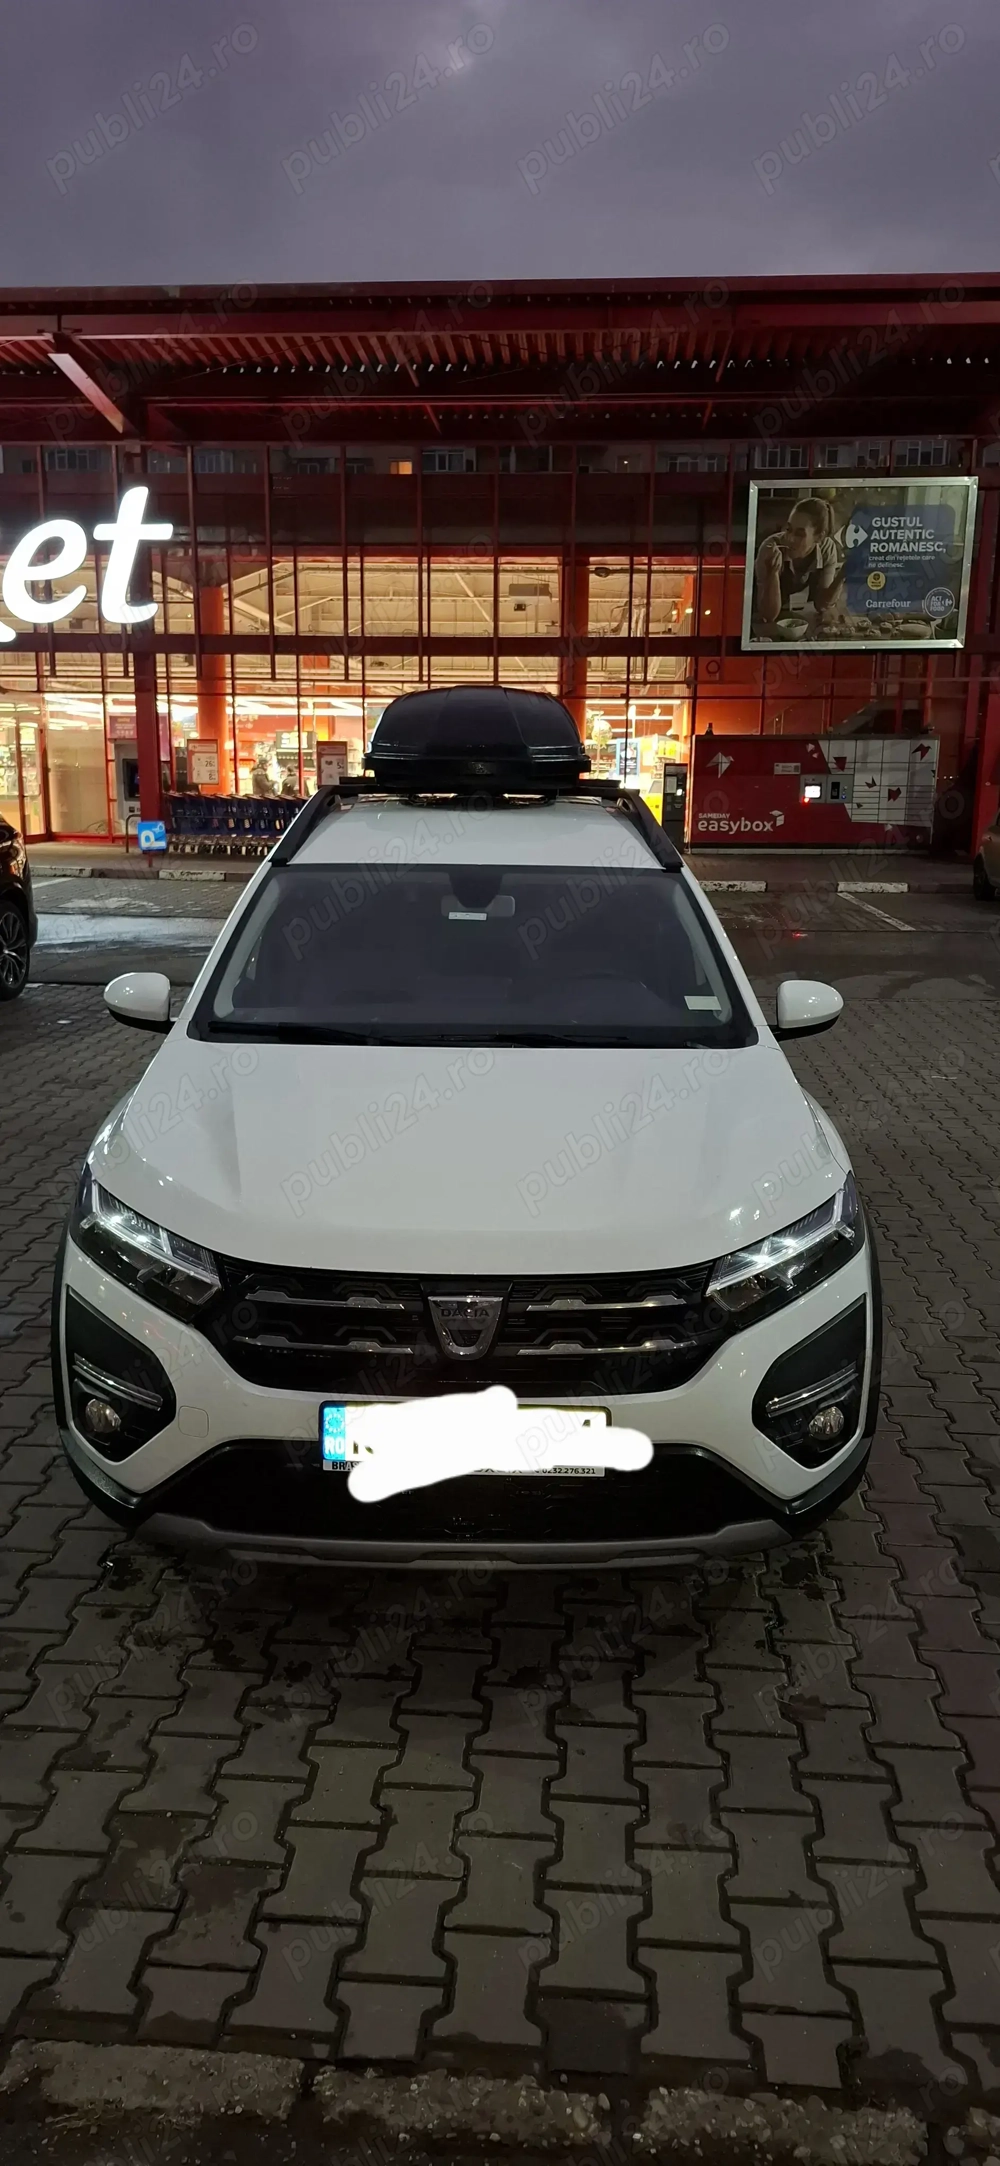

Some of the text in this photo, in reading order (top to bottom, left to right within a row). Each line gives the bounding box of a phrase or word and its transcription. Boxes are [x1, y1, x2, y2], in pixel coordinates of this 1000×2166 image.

[872, 516, 923, 527] GUSTUL
[870, 529, 935, 540] AUTENTIC
[870, 539, 947, 553] ROMÂNESC,
[0, 486, 173, 643] et
[865, 599, 912, 608] Carrefour
[697, 817, 773, 835] easybox
[441, 1308, 490, 1318] DACIA
[324, 1437, 345, 1454] RO
